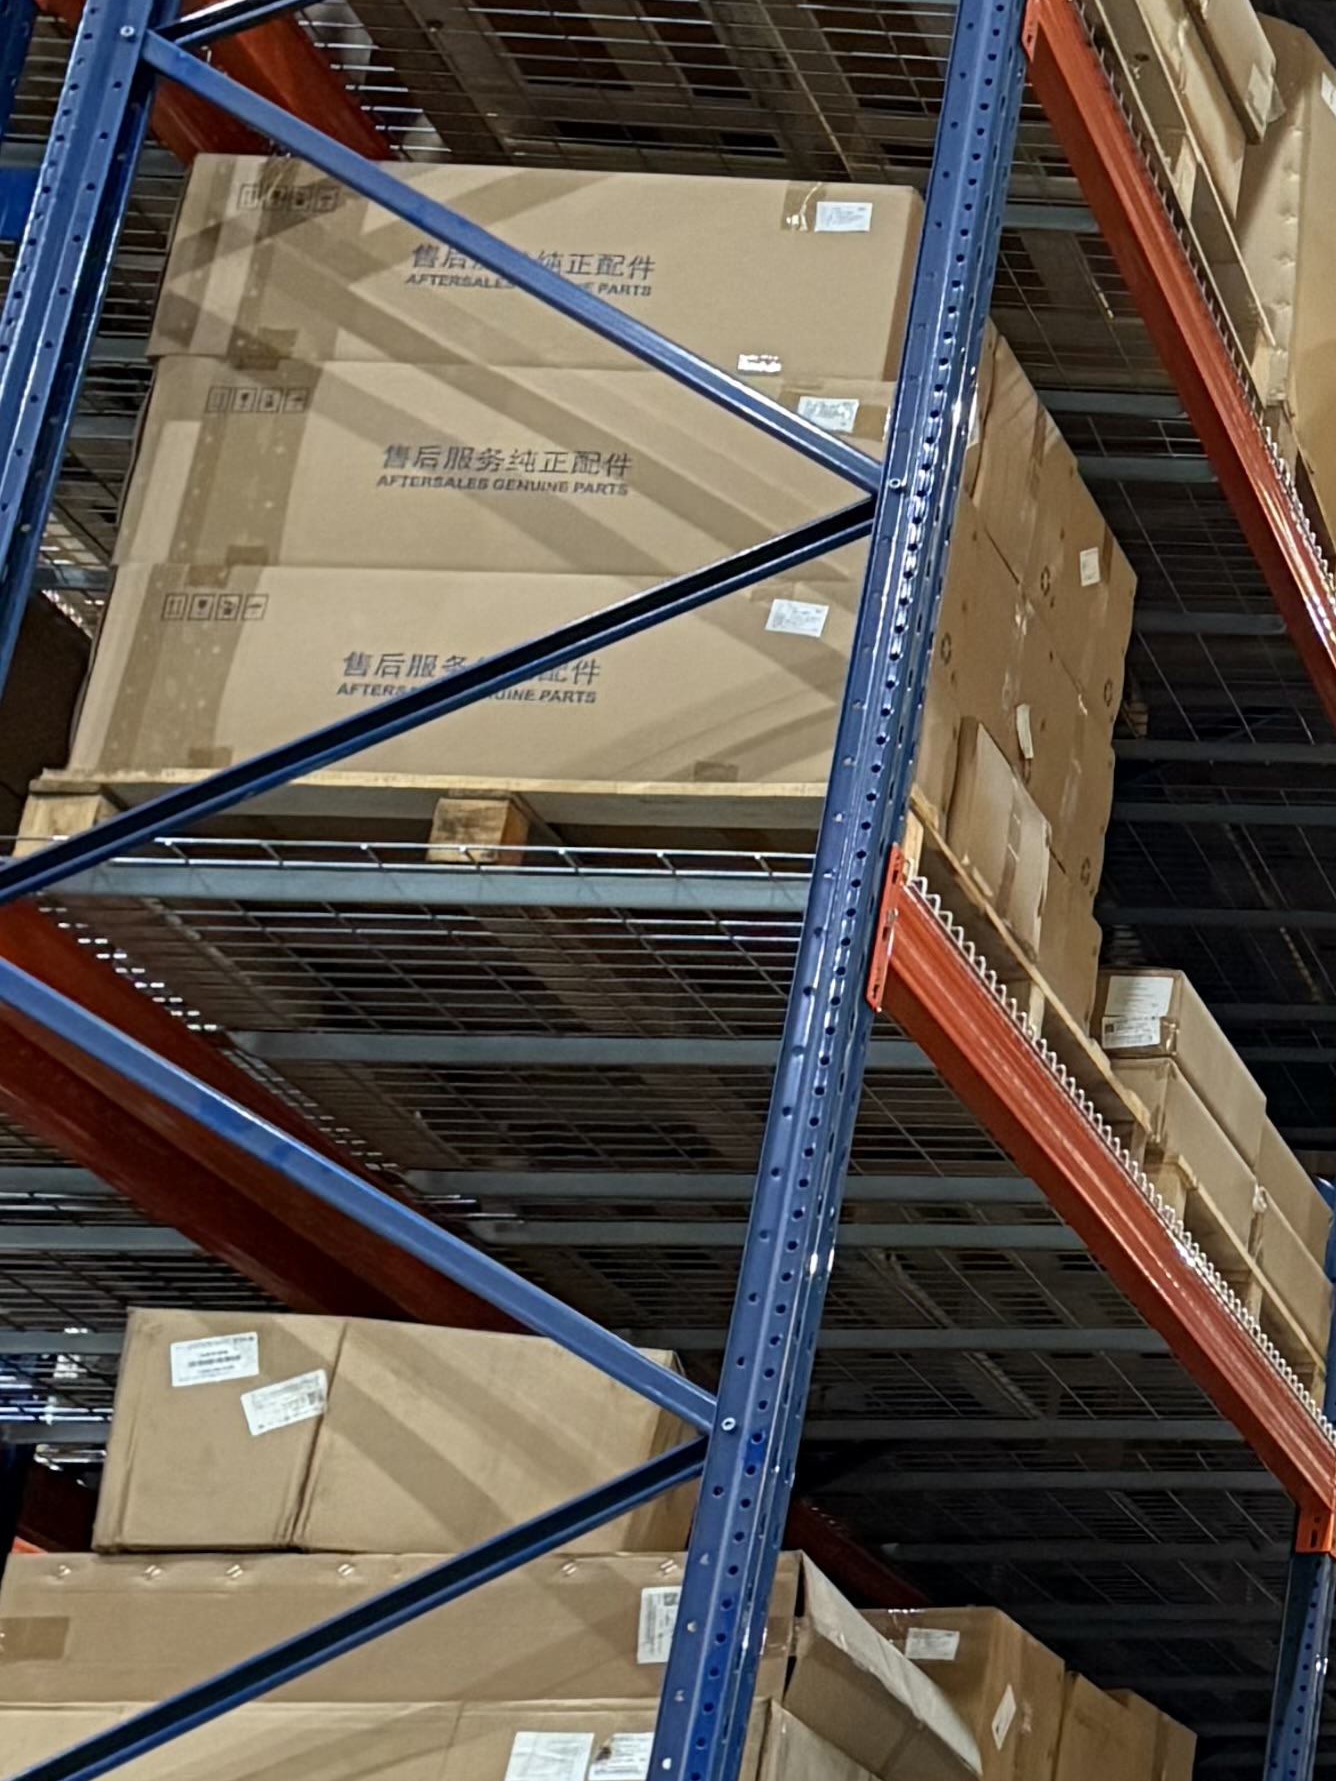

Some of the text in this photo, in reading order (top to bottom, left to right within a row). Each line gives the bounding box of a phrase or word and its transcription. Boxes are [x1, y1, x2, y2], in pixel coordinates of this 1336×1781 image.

[412, 244, 656, 281] 售后纯正配件
[599, 283, 652, 296] PARTS
[384, 445, 632, 477] 售后服务纯正配件
[377, 475, 629, 496] AFTERSALES GENUINE PARTS
[539, 689, 596, 704] PARTS
